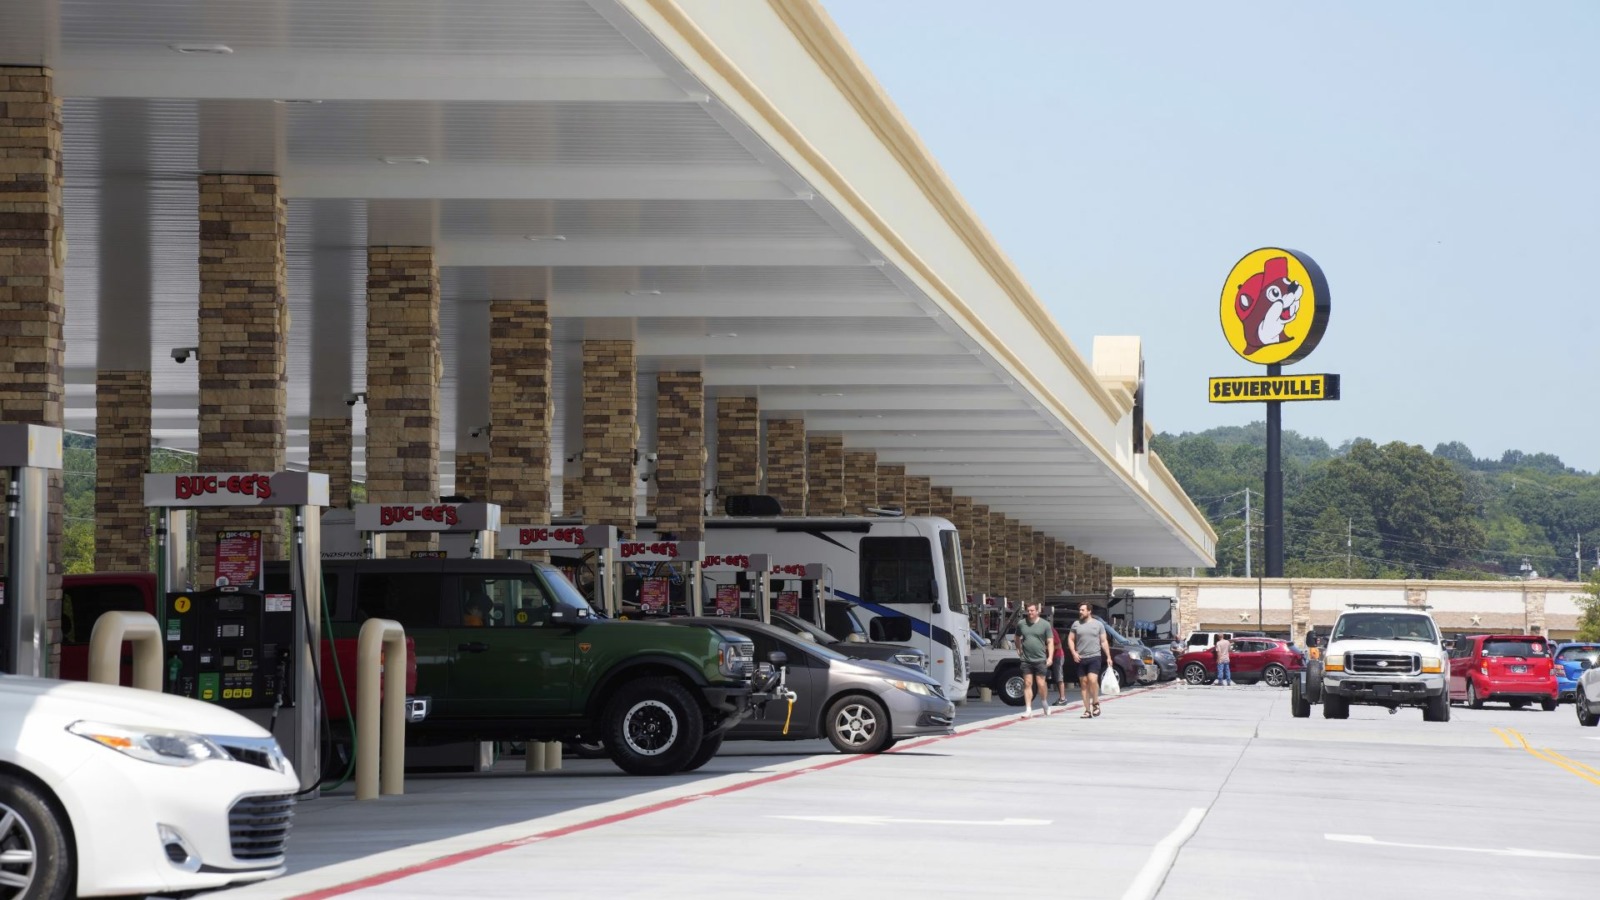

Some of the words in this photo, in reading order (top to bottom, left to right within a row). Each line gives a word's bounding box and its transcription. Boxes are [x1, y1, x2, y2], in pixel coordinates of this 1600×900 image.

[1213, 380, 1320, 397] SEVIERVILLE
[176, 474, 271, 499] BUC-EE'S
[381, 504, 458, 525] BUC-EE'S
[180, 601, 186, 609] 7
